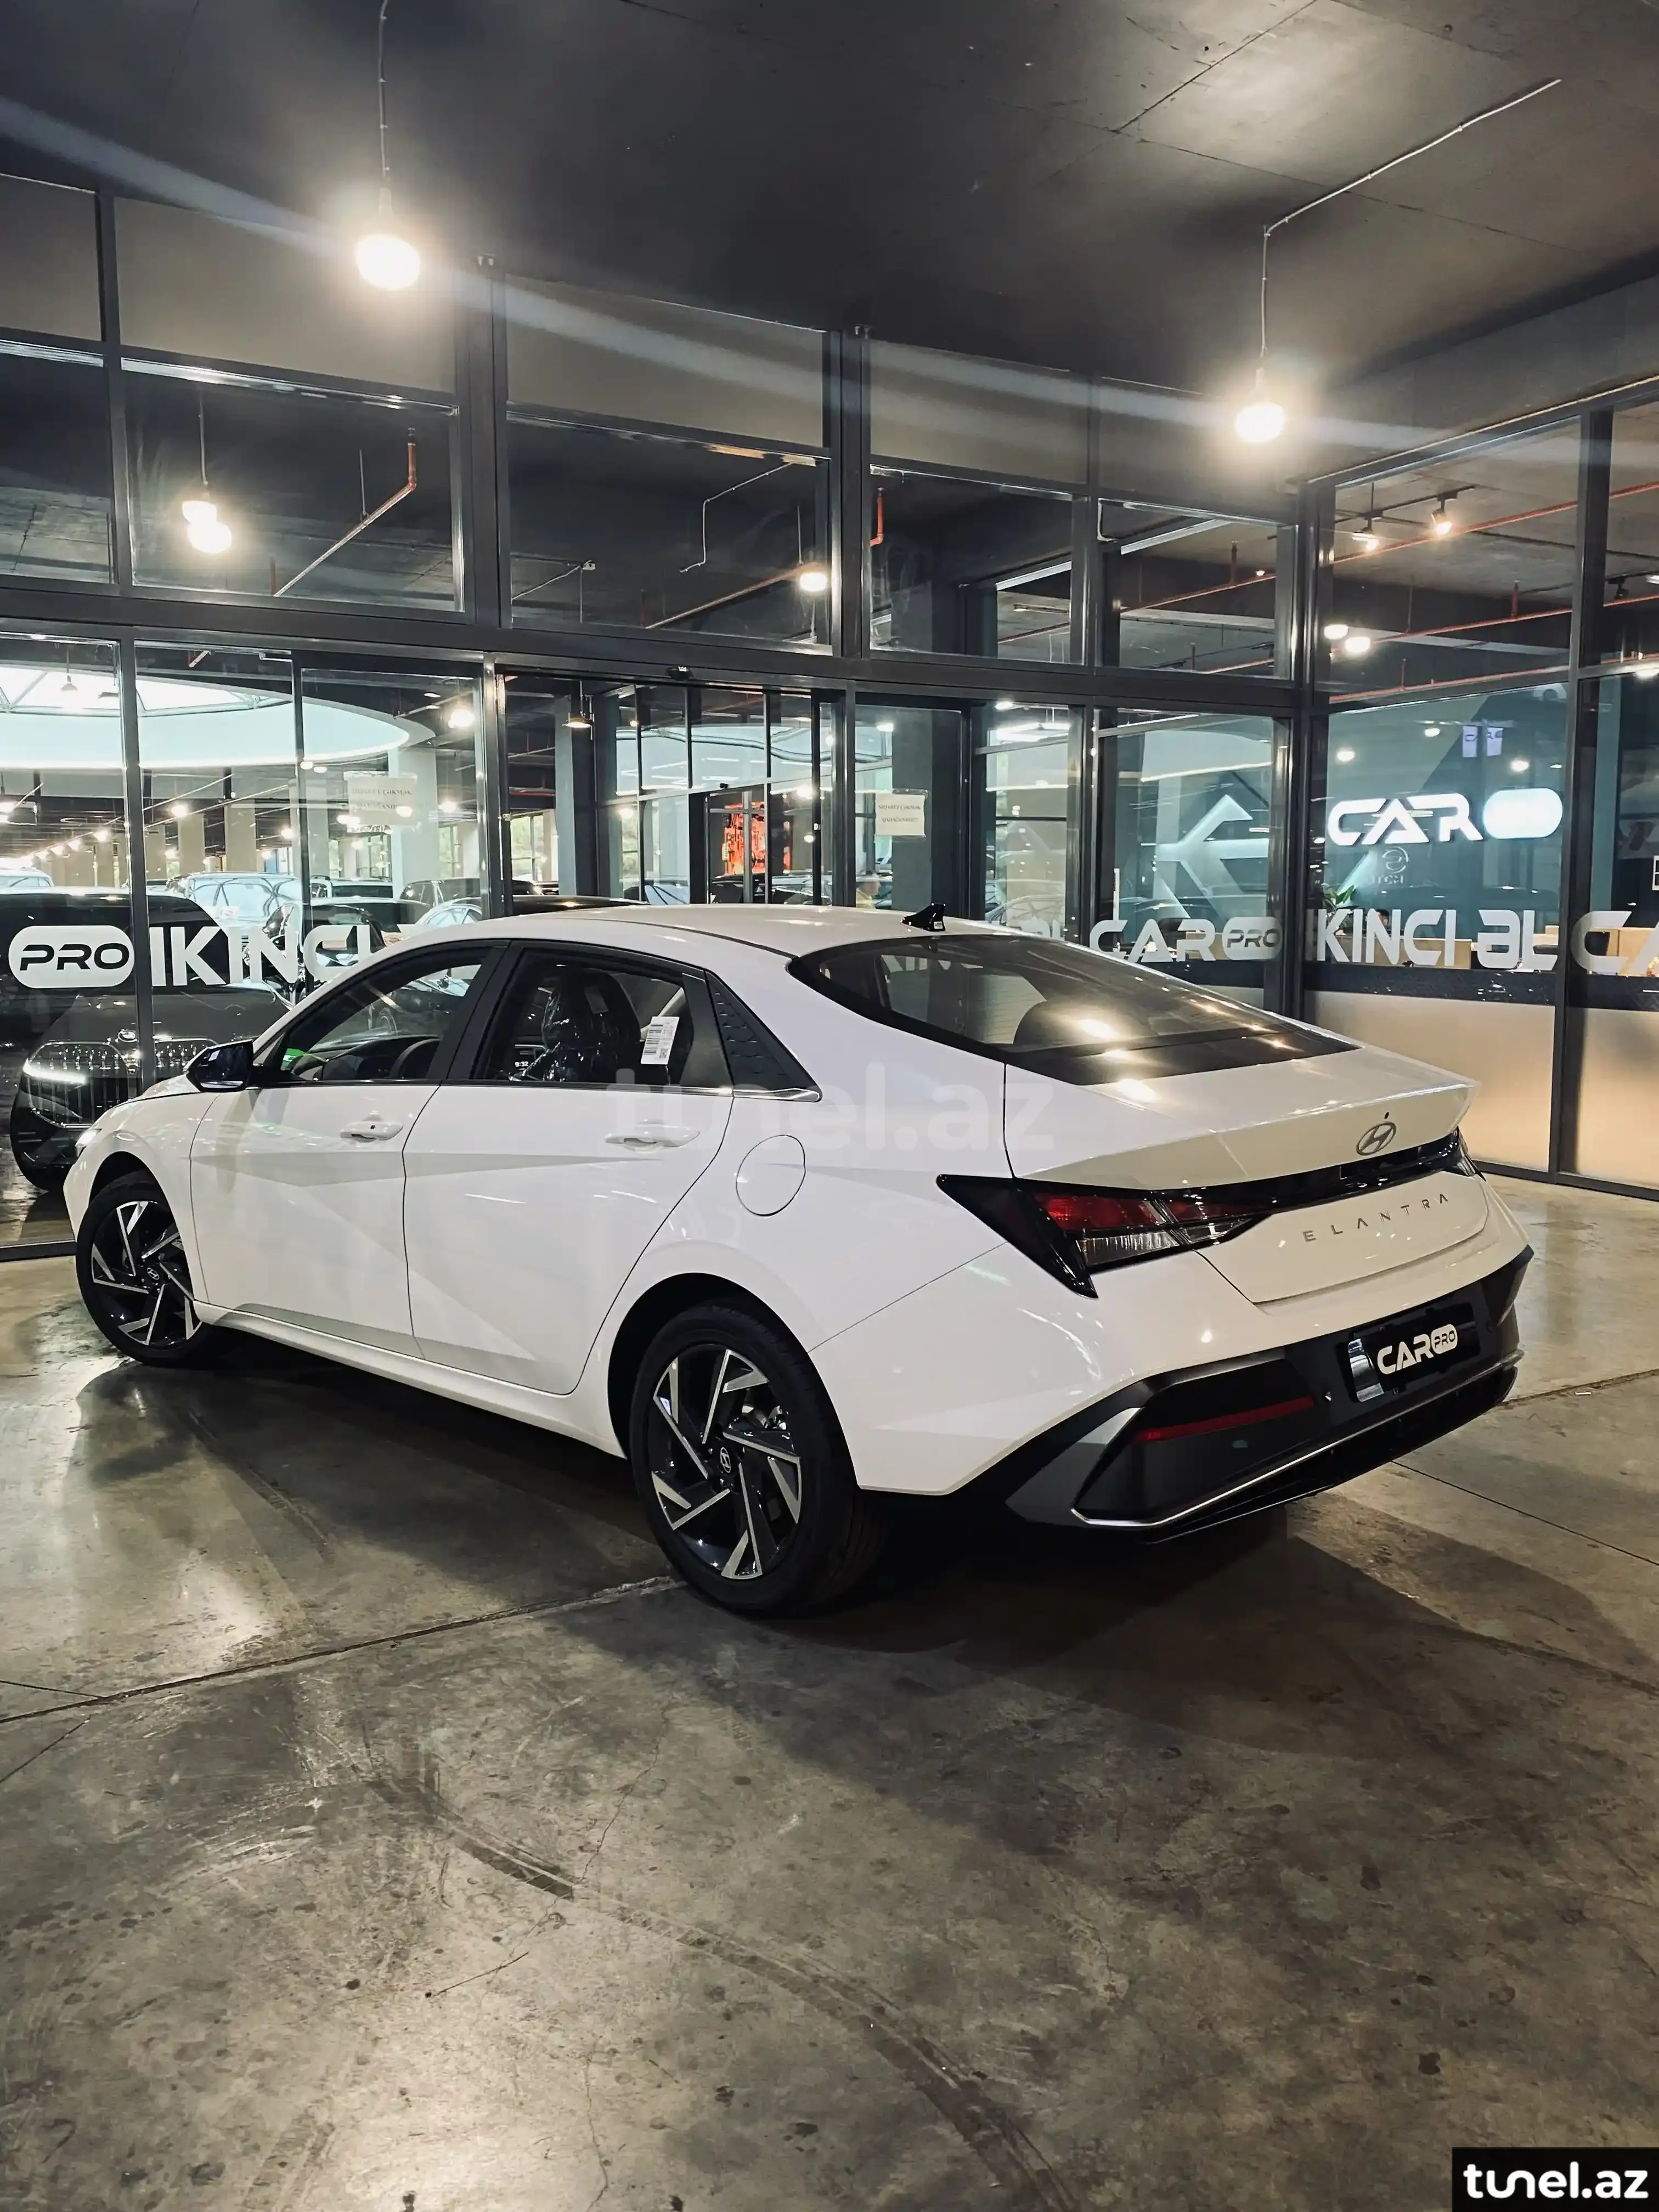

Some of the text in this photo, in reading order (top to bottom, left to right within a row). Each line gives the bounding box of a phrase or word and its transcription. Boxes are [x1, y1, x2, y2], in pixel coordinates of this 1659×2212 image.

[1328, 792, 1484, 847] CAR
[1090, 918, 1216, 963] CAR
[1302, 1193, 1448, 1243] ELANTRA
[1377, 1330, 1455, 1375] CAR PRO
